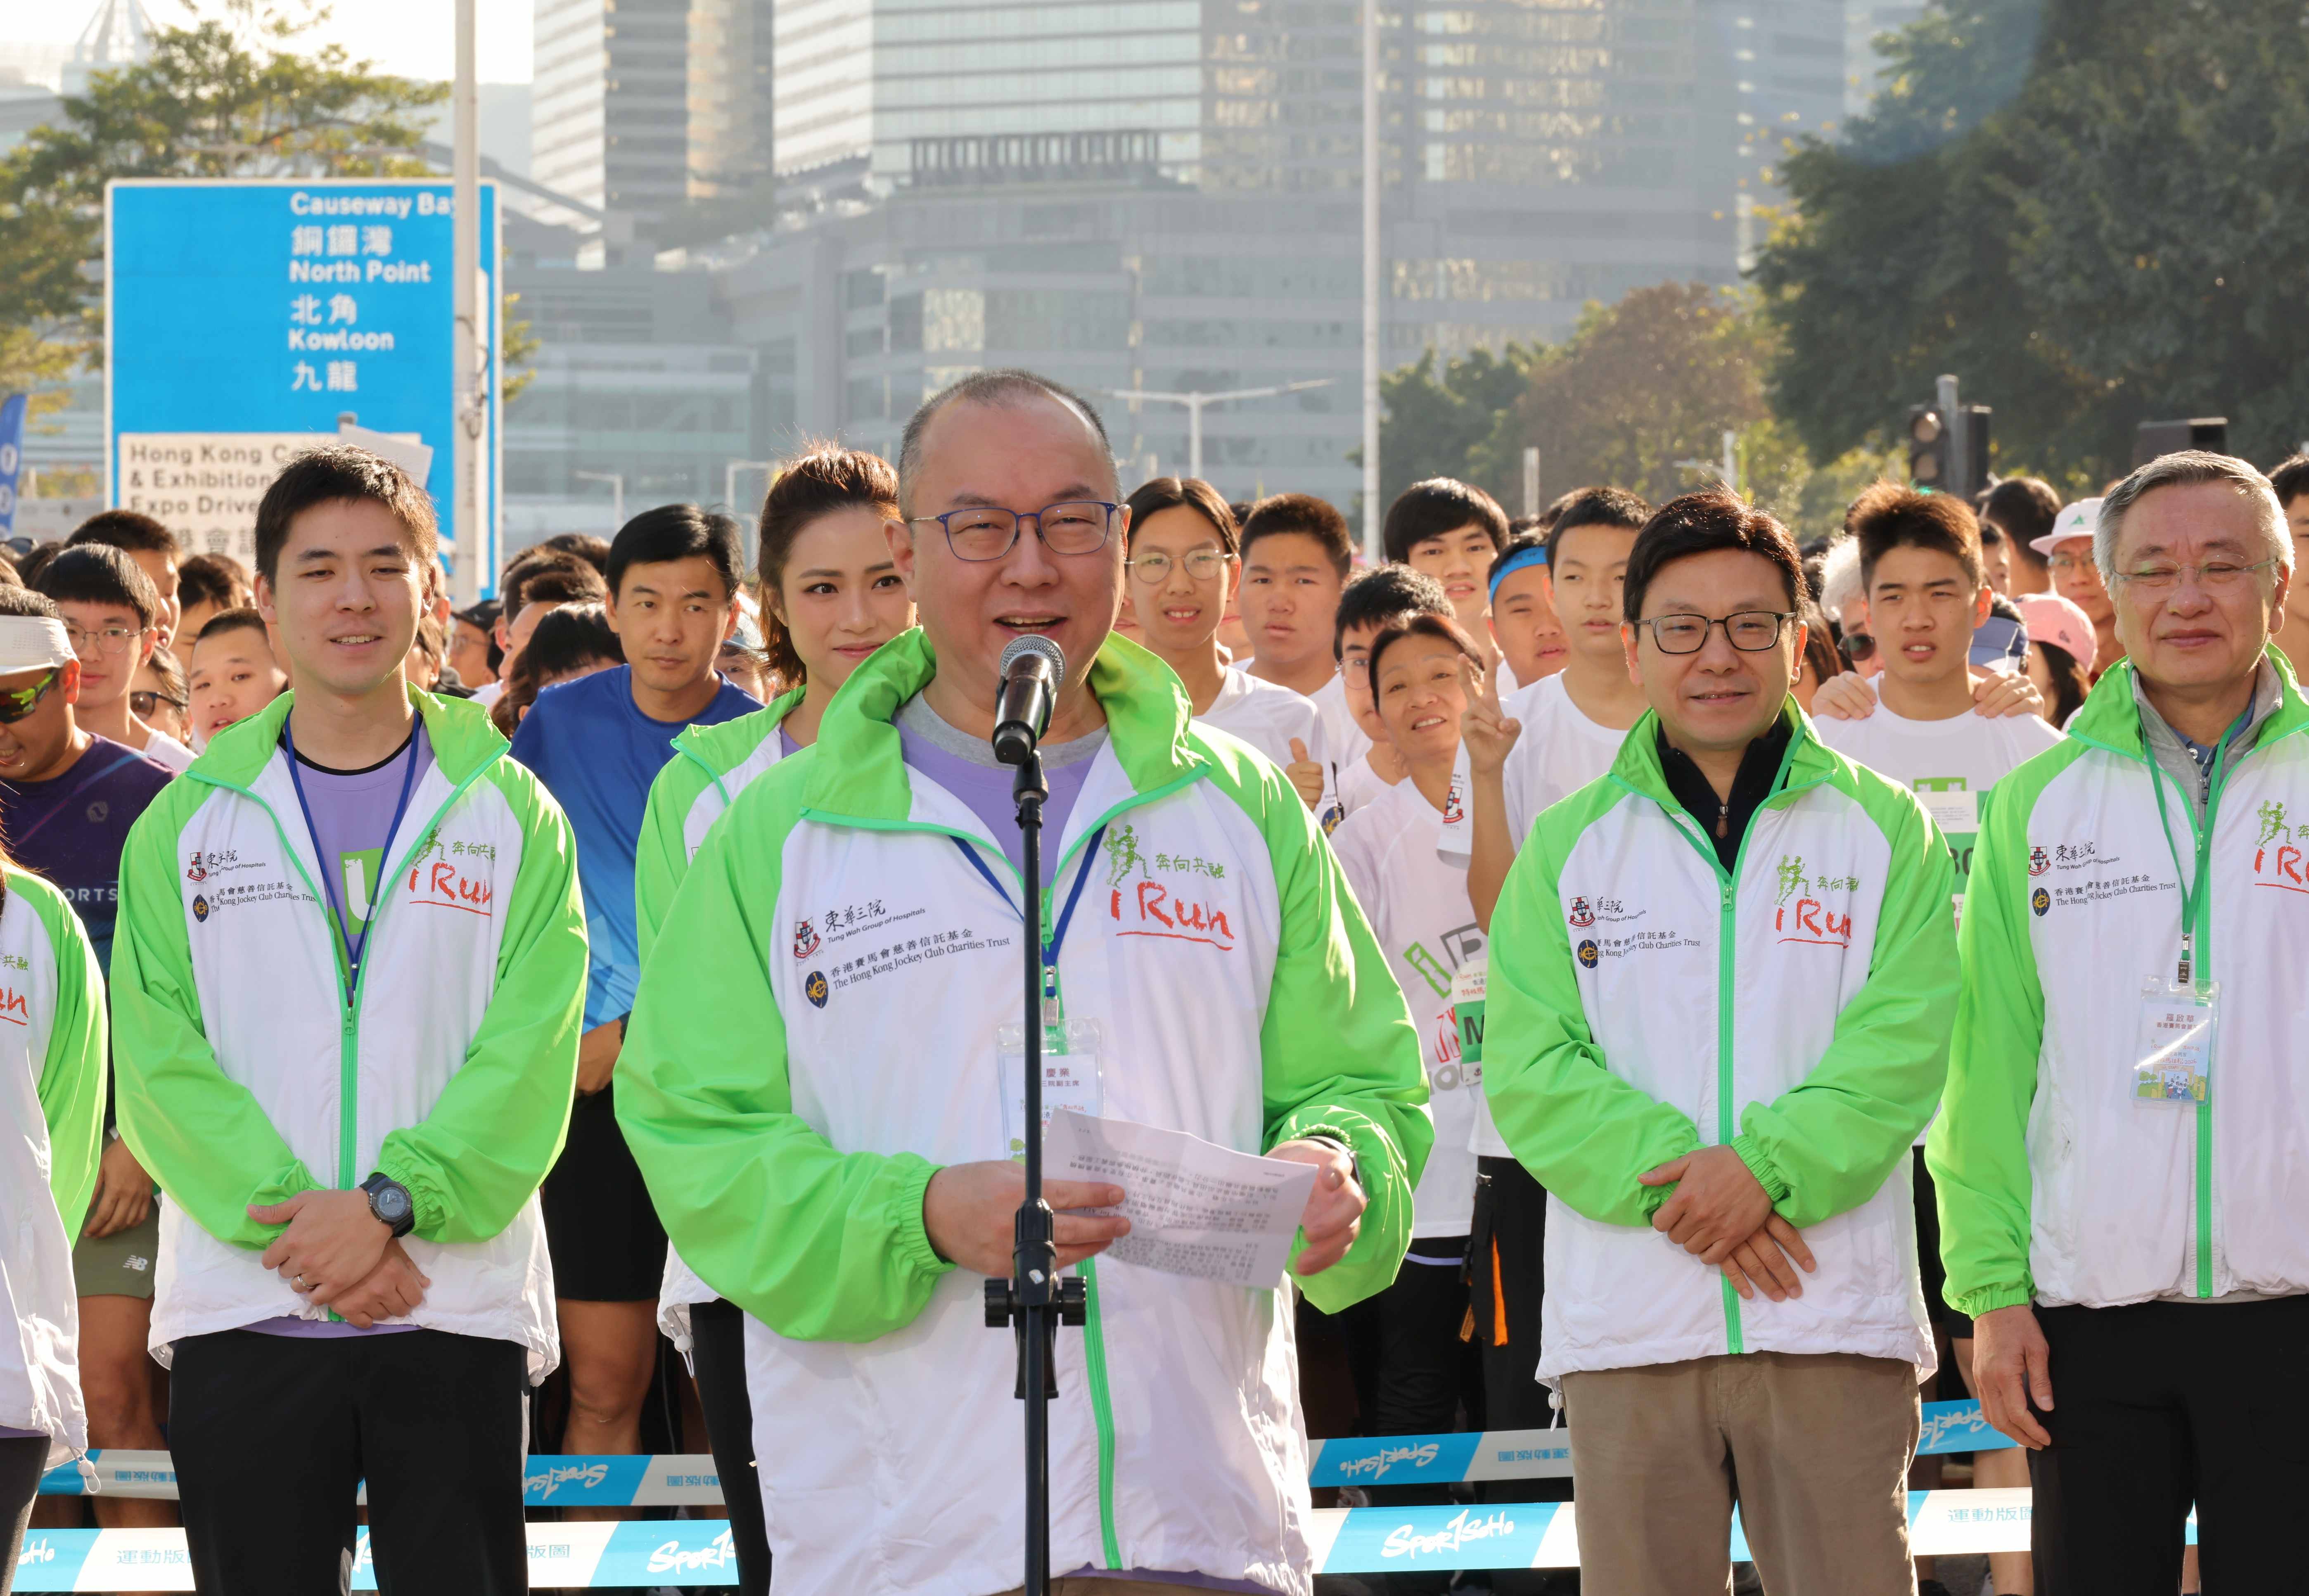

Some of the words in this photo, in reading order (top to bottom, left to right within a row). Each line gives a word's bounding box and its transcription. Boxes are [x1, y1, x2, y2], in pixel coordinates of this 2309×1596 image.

[290, 193, 412, 218] Causeway
[291, 226, 392, 256] 銅鑼灣
[289, 261, 360, 283] North
[367, 261, 431, 283] Point
[290, 294, 357, 325] 北角
[289, 330, 394, 351] Kowloon
[292, 361, 358, 391] 九龍
[130, 444, 192, 466] Hong
[201, 444, 262, 466] Kong
[130, 470, 142, 488] &
[154, 470, 271, 488] Exhibition
[130, 496, 188, 515] Expo
[1156, 853, 1225, 879] 奔向共融
[220, 896, 236, 906] Kong
[237, 894, 257, 906] Jockey
[258, 892, 273, 901] Club
[301, 894, 318, 903] Trus
[2056, 898, 2069, 906] The
[2114, 888, 2127, 896] Club
[2129, 884, 2157, 894] Charities
[2159, 882, 2176, 890] Trust
[827, 934, 845, 944] Tung
[846, 927, 861, 937] Wah
[862, 921, 883, 932] Group
[884, 916, 892, 925] of
[893, 908, 926, 922] Hospitals
[830, 928, 973, 978] 香港賽馬會慈善信託基金
[1605, 949, 1622, 958] Kong
[1638, 941, 1654, 949] Club
[1655, 939, 1682, 949] Charities
[1683, 938, 1700, 947] Trust
[833, 978, 849, 990] The
[849, 970, 872, 984] Hong
[872, 962, 894, 975] Kong
[894, 953, 923, 970] Jockey
[924, 946, 945, 959] Club
[946, 940, 985, 954] Charities
[986, 937, 1010, 948] Trust
[116, 1549, 192, 1565] 運動版
